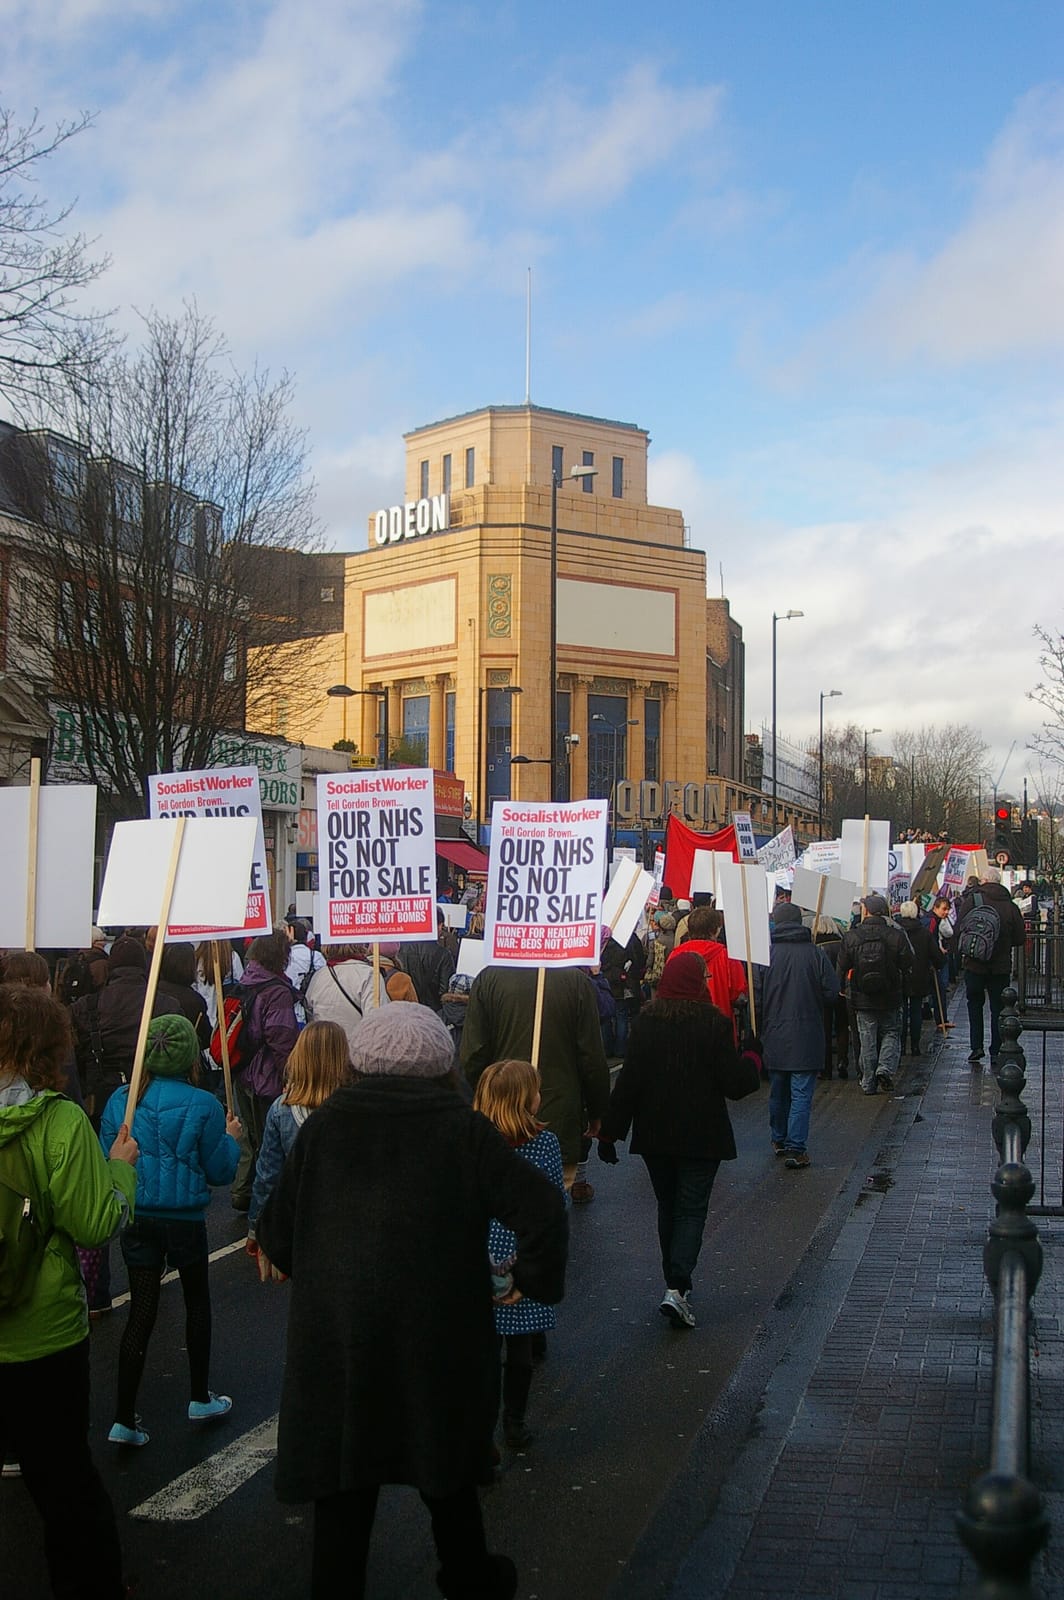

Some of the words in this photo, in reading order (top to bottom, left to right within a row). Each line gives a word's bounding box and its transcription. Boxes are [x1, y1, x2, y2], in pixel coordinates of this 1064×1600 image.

[375, 493, 447, 545] ODEON
[157, 800, 168, 811] Tell
[170, 799, 195, 810] Gordon
[327, 800, 340, 810] Tell
[342, 798, 370, 810] Gordon
[616, 780, 721, 822] ODEON
[328, 810, 371, 840] OUR
[380, 807, 424, 838] NHS
[501, 826, 514, 836] Tell
[517, 827, 546, 838] Gordon
[328, 840, 348, 869] IS
[356, 838, 400, 868] NOT
[500, 838, 545, 866] OUR
[553, 837, 594, 866] NHS
[329, 869, 370, 898] FOR
[378, 866, 432, 896] SALE
[498, 866, 519, 894] IS
[528, 867, 572, 895] NOT
[332, 902, 360, 914] MONEY
[362, 901, 378, 913] FOR
[380, 900, 410, 912] HEALTH
[413, 899, 430, 911] NOT
[332, 914, 352, 926] WAR:
[355, 913, 376, 924] BEDS
[378, 912, 396, 924] NOT
[397, 911, 426, 923] BOMBS
[496, 894, 540, 922] FOR
[546, 892, 598, 923] SALE
[496, 938, 519, 949] WAR:
[521, 938, 542, 950] BEDS
[544, 938, 562, 950] NOT
[562, 936, 590, 949] BOMBS
[497, 926, 527, 938] MONEY
[528, 927, 546, 939] FOR
[547, 926, 576, 938] HEALTH
[577, 924, 594, 936] NOT
